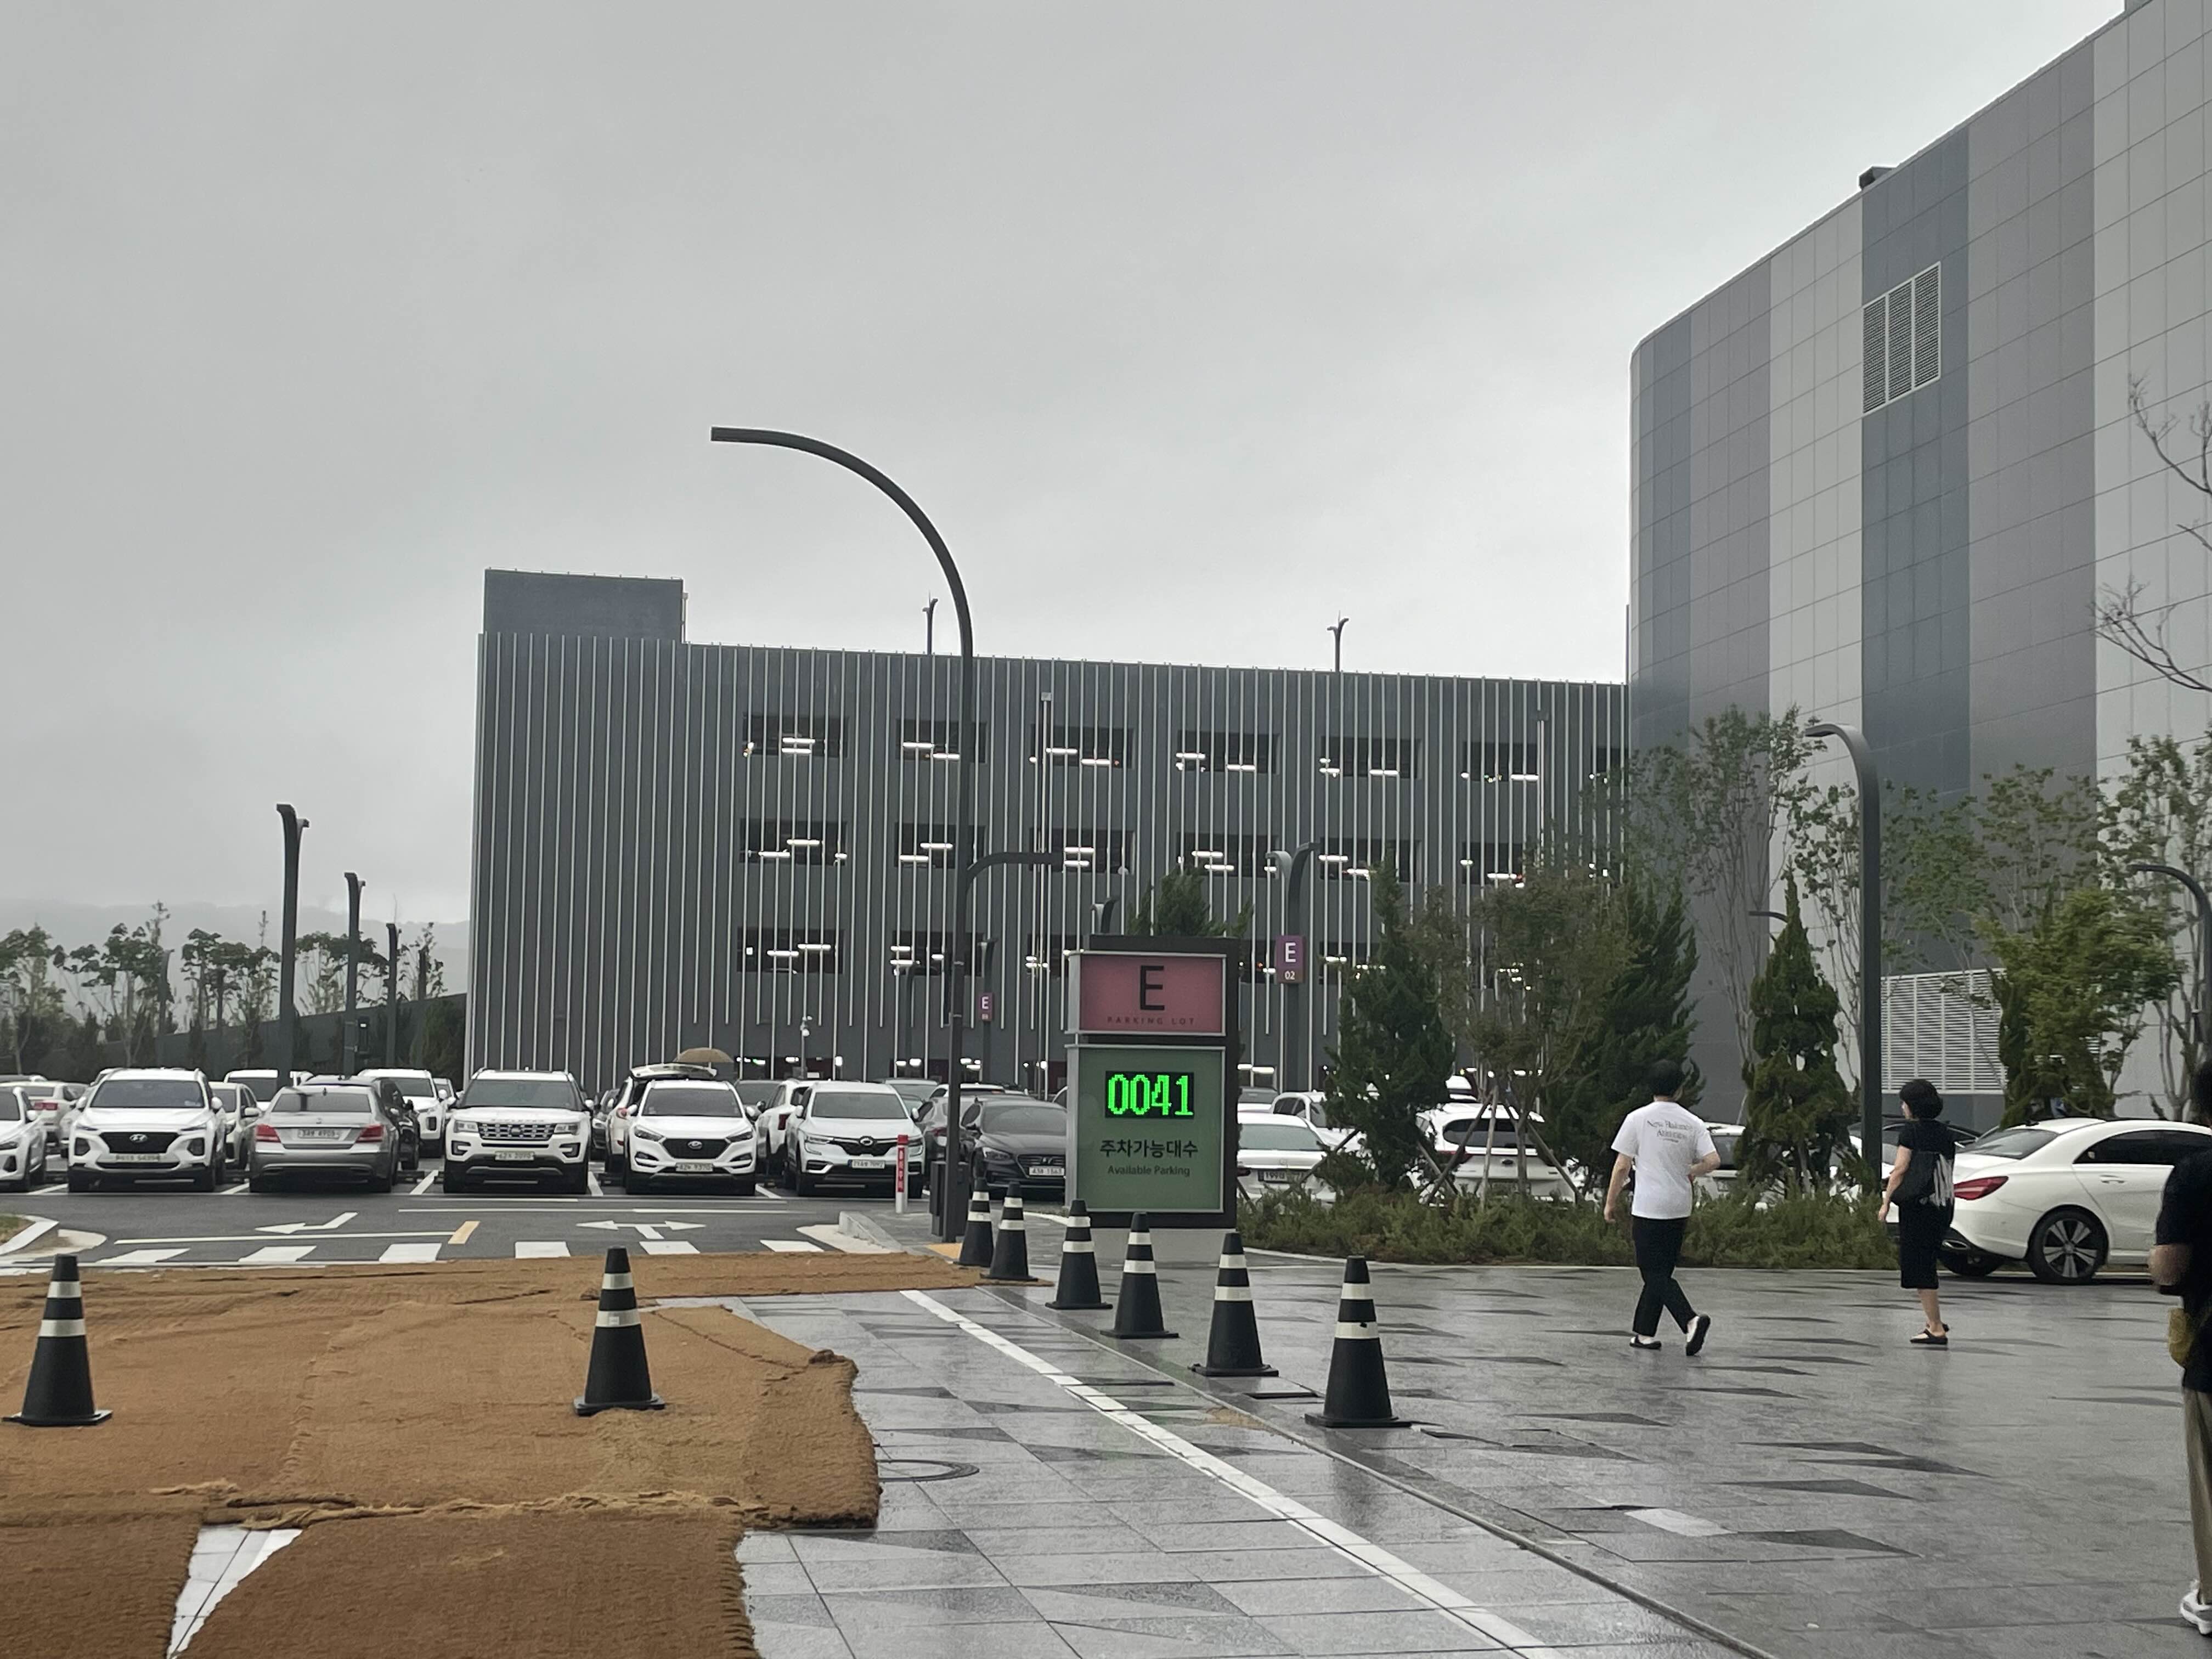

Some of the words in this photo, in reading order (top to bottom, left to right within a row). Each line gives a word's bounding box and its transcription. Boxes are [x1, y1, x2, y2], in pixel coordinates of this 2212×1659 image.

[1285, 942, 1296, 962] E
[1285, 970, 1295, 980] 02
[1140, 965, 1165, 1011] E
[982, 996, 989, 1009] E
[1107, 1016, 1164, 1025] PARKING
[1171, 1017, 1194, 1025] LOT
[1108, 1074, 1194, 1116] 0041
[1100, 1139, 1198, 1158] 주차가능대수
[1108, 1165, 1152, 1176] Available
[1154, 1165, 1190, 1177] Parking
